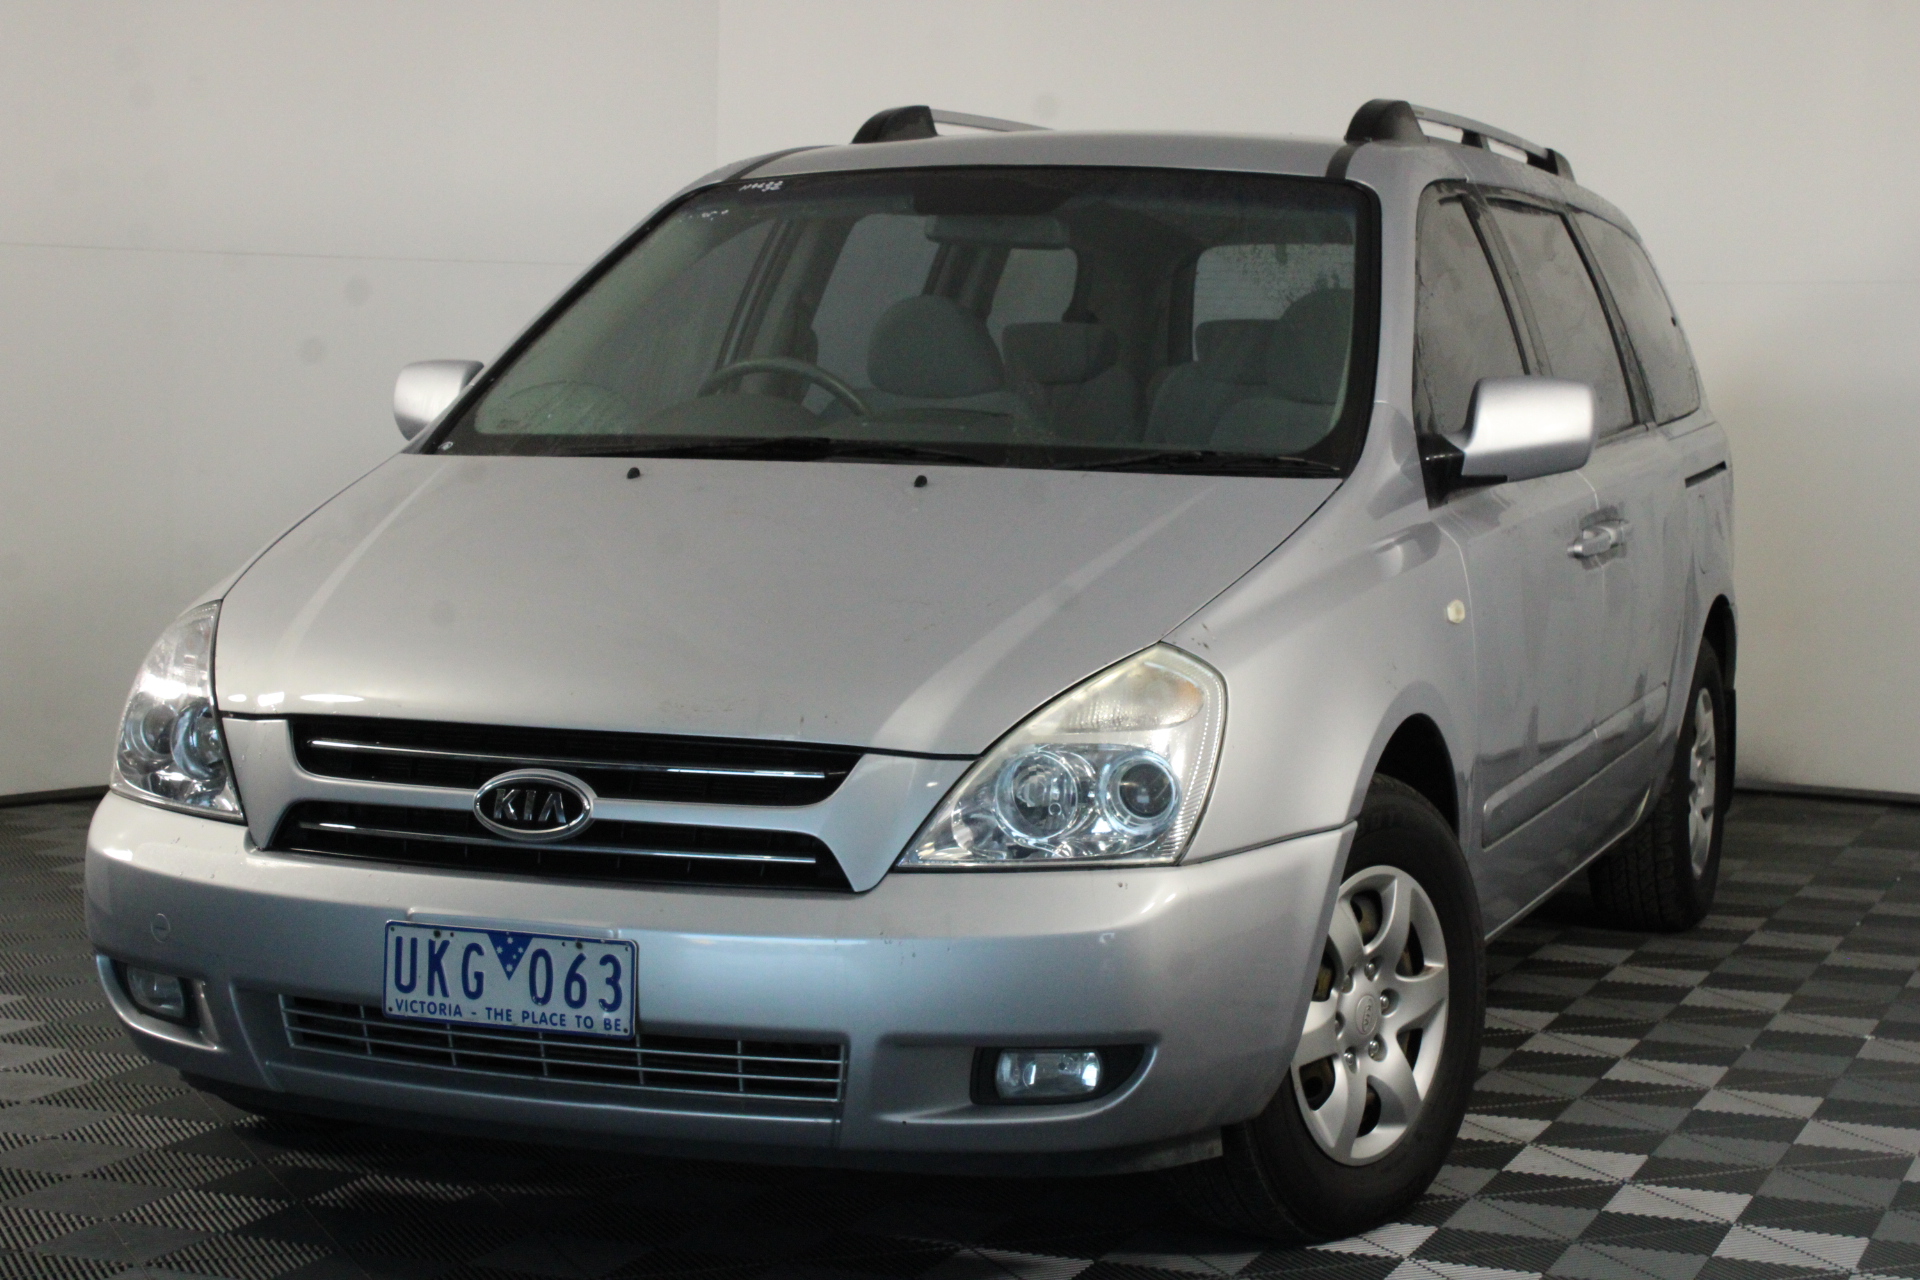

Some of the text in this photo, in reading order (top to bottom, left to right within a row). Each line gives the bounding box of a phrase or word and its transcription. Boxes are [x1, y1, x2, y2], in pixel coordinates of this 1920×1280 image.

[493, 788, 567, 824] KIA
[394, 935, 623, 1013] UKG 063
[395, 998, 463, 1018] VICTORIA
[485, 1007, 513, 1023] THE
[522, 1010, 567, 1027] PLACE
[575, 1015, 594, 1030] TO
[603, 1018, 622, 1032] BE
